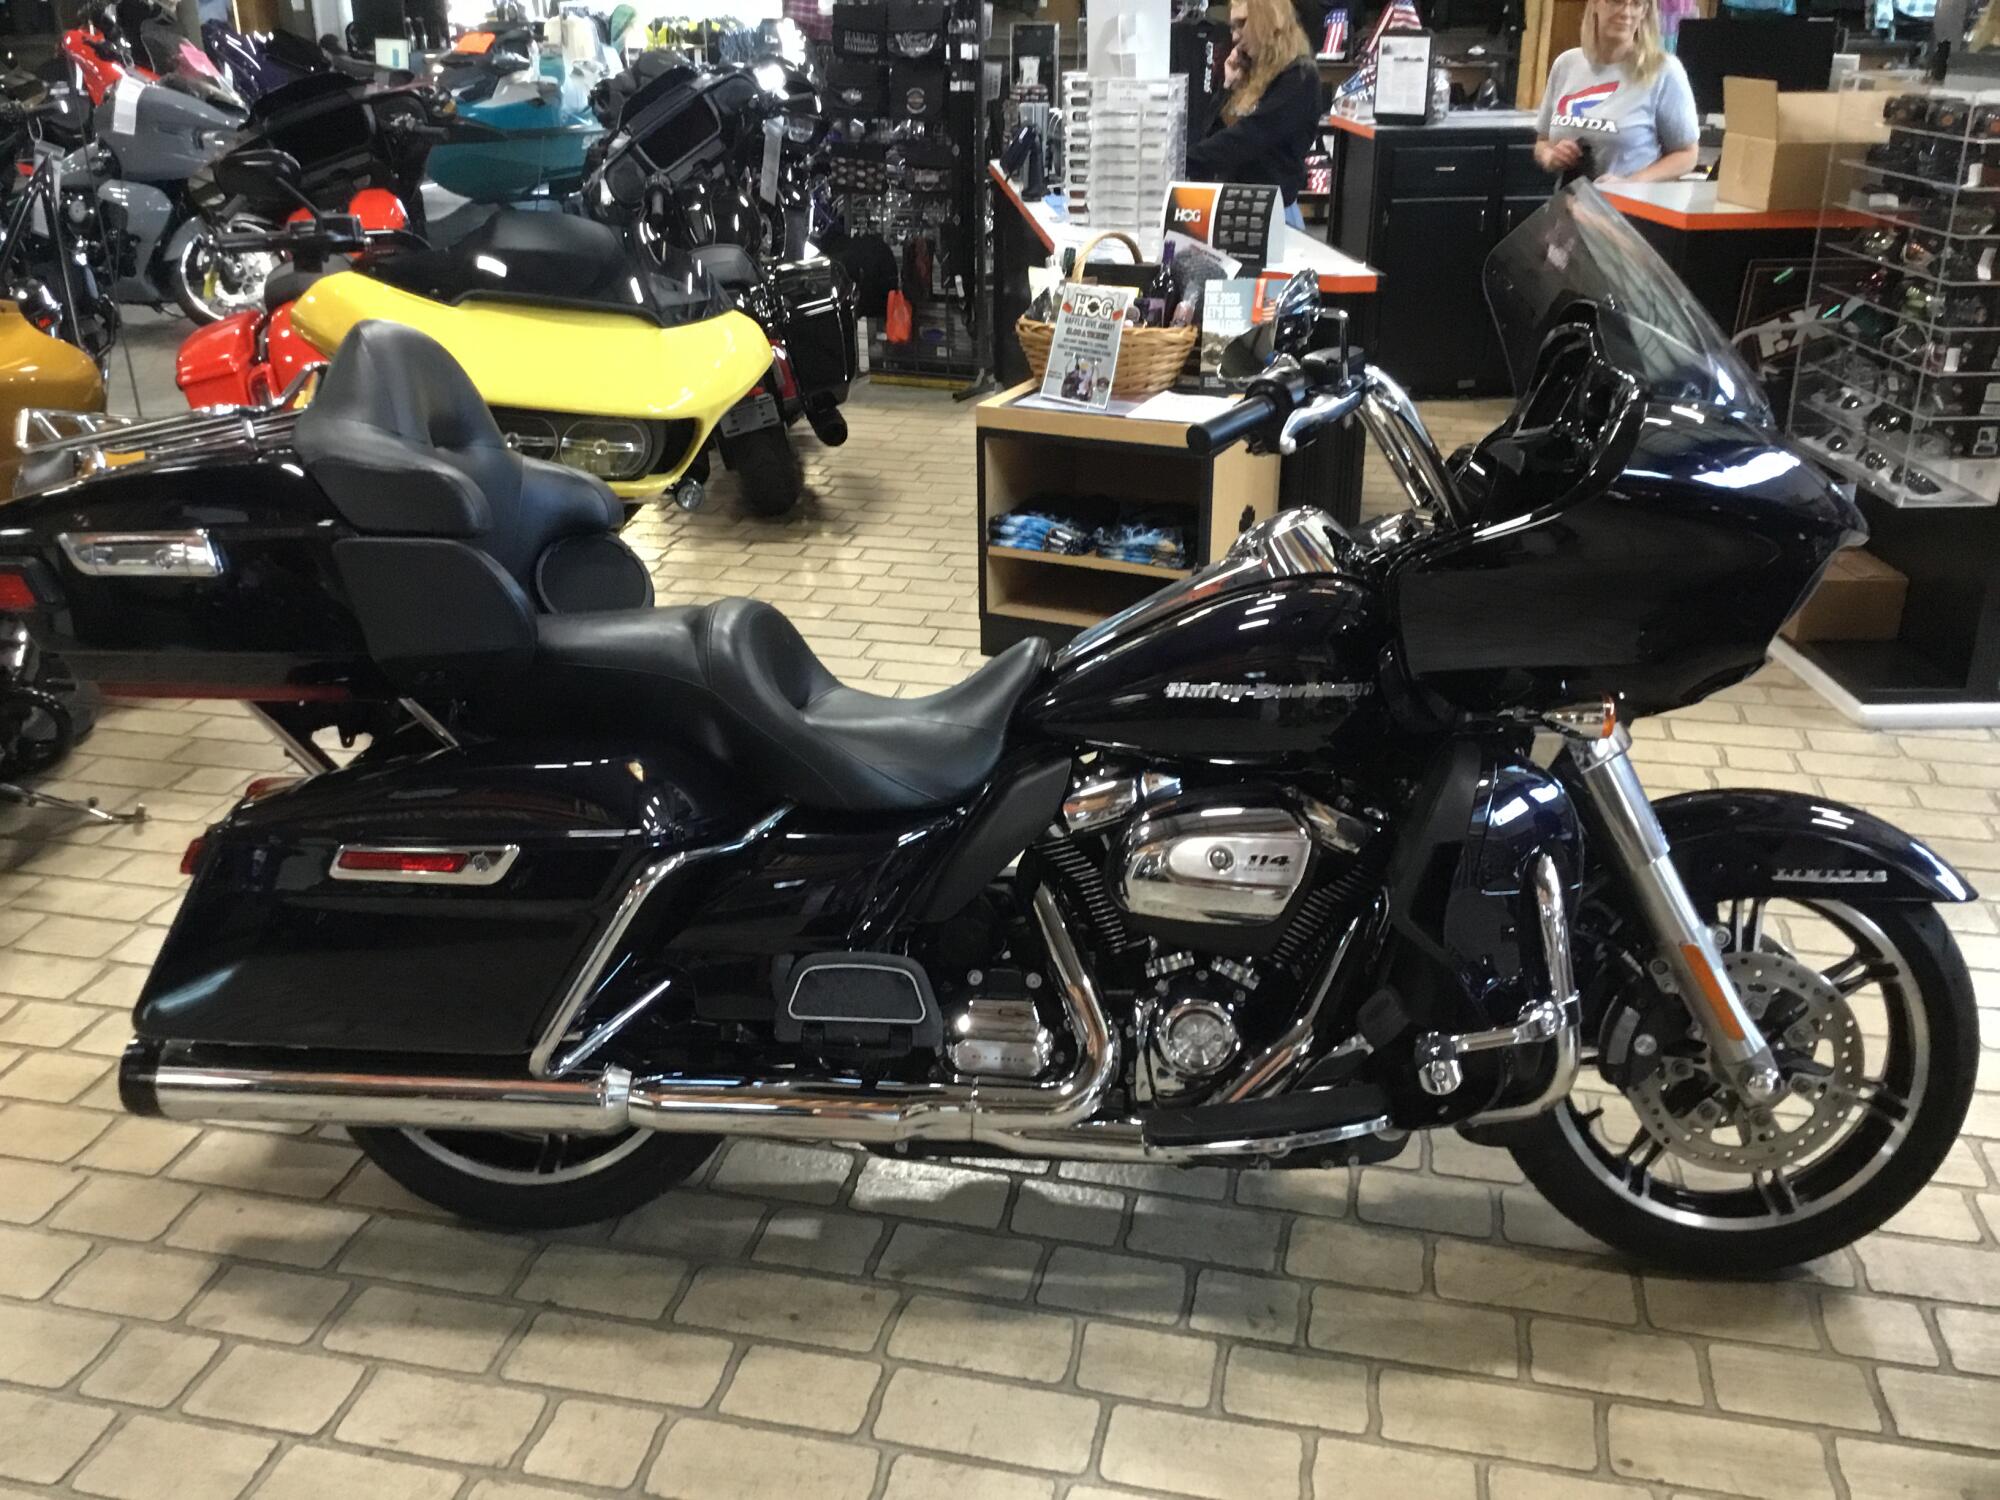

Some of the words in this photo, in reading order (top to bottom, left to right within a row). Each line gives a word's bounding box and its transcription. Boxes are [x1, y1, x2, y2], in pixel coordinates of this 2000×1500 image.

[1550, 112, 1618, 132] HONDA
[1174, 207, 1202, 223] HOG
[1073, 293, 1114, 320] HOG
[1247, 855, 1291, 867] 114
